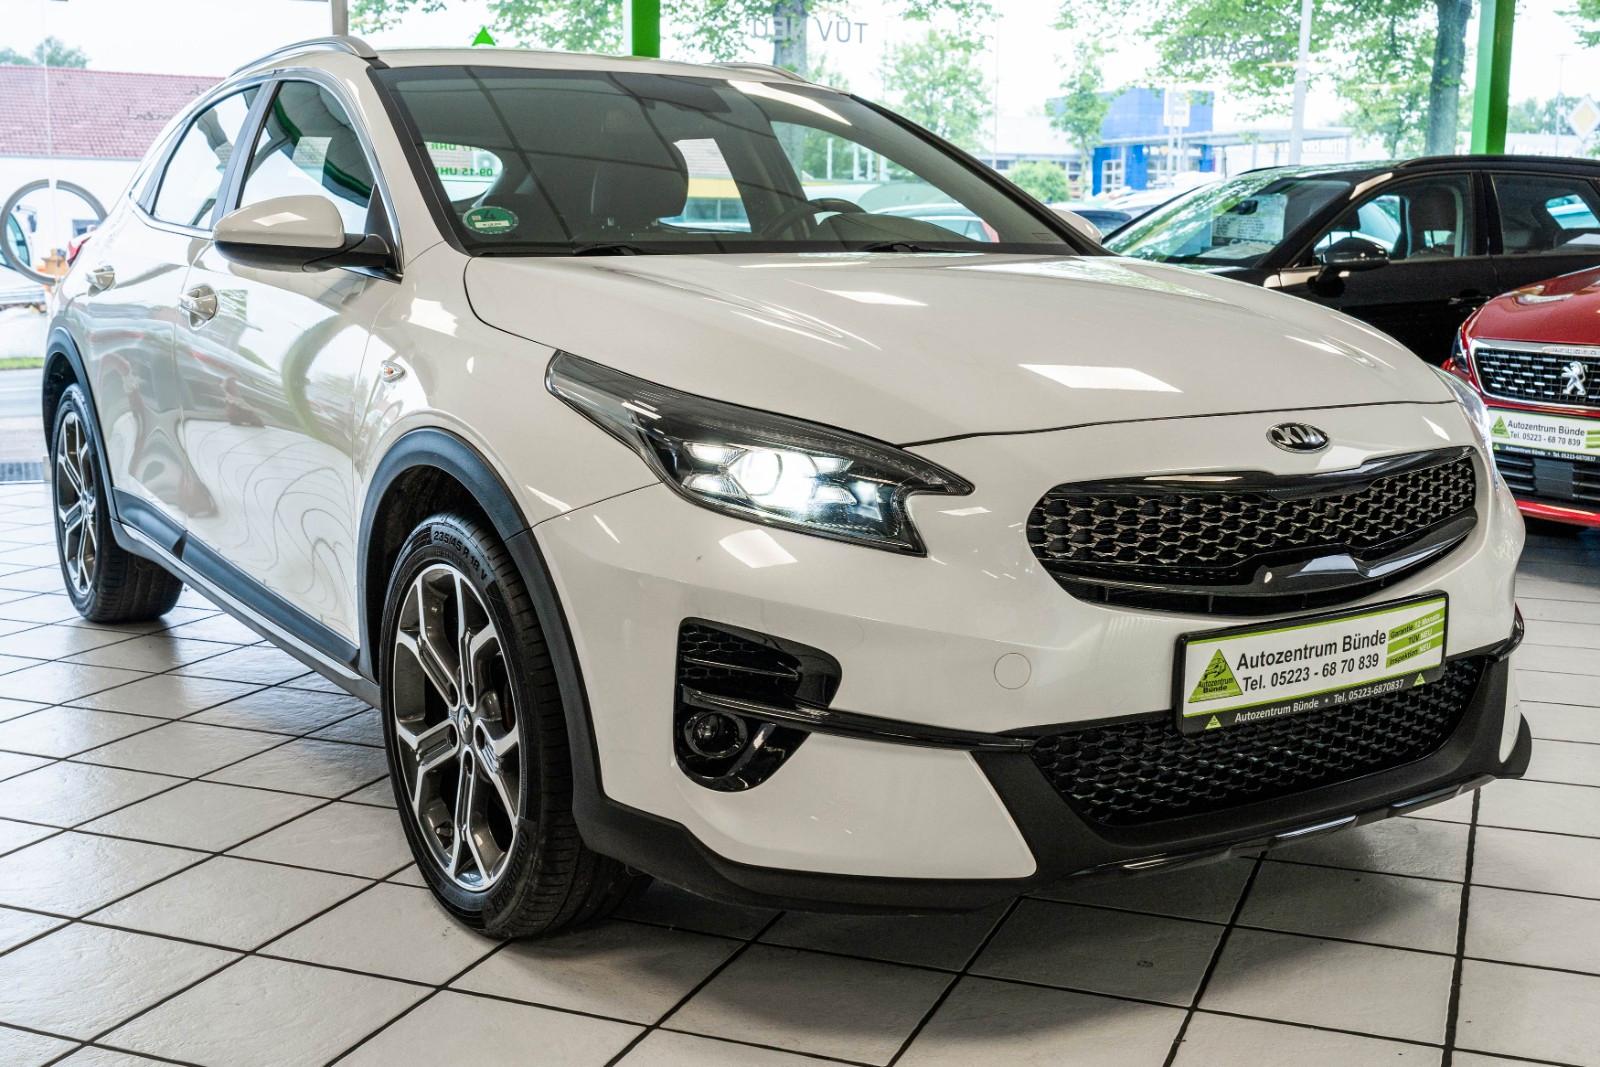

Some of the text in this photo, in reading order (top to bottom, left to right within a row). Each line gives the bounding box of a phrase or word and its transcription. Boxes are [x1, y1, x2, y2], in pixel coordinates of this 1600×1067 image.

[1270, 425, 1327, 447] KIA
[1508, 420, 1556, 434] Autozentrum
[463, 547, 470, 558] R
[1390, 623, 1413, 639] Garantie
[1236, 629, 1387, 671] Autozentrum Bünde
[1242, 675, 1267, 692] Tel.
[1271, 667, 1310, 688] 05223
[1321, 660, 1337, 677] 68
[1341, 657, 1355, 674] 70
[1358, 652, 1379, 670] 839
[1198, 677, 1233, 688] Autozentrum
[1234, 706, 1291, 723] Autozentrum
[1293, 698, 1319, 712] Bünde
[1334, 693, 1347, 704] Tel.
